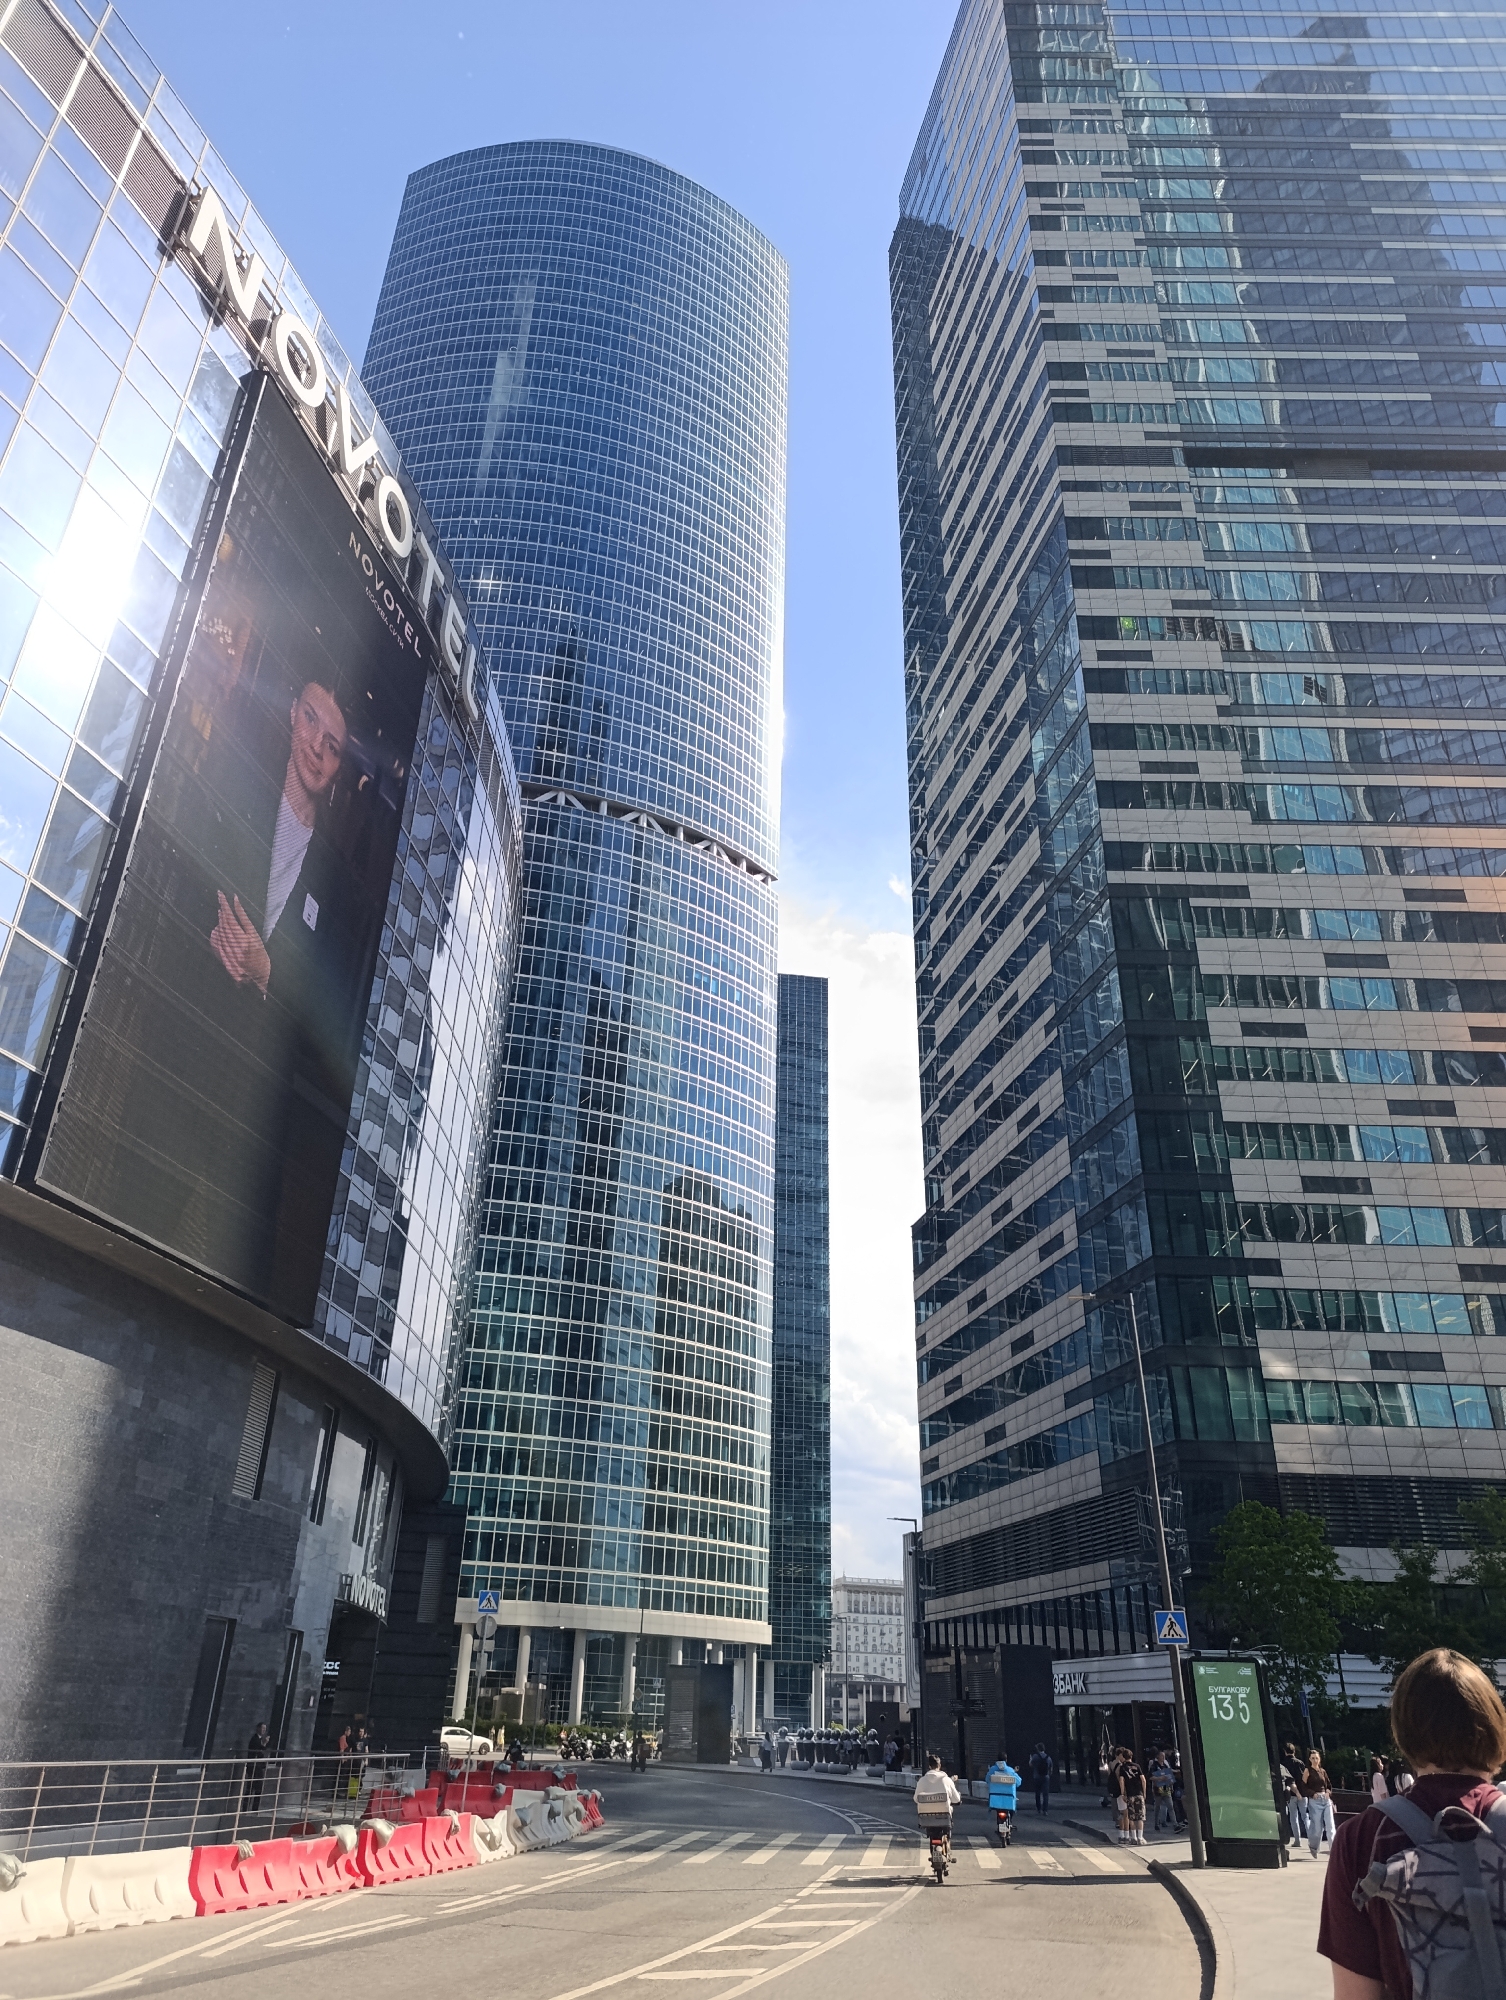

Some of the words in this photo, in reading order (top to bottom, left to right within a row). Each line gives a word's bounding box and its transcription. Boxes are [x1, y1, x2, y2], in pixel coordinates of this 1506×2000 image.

[187, 186, 480, 721] NOVOTEL
[349, 531, 421, 658] NOVOTEL
[350, 1573, 387, 1618] NOVOTEL
[1052, 1672, 1087, 1694] ЗБАНК
[1208, 1685, 1251, 1694] БУЛГАКОВУ
